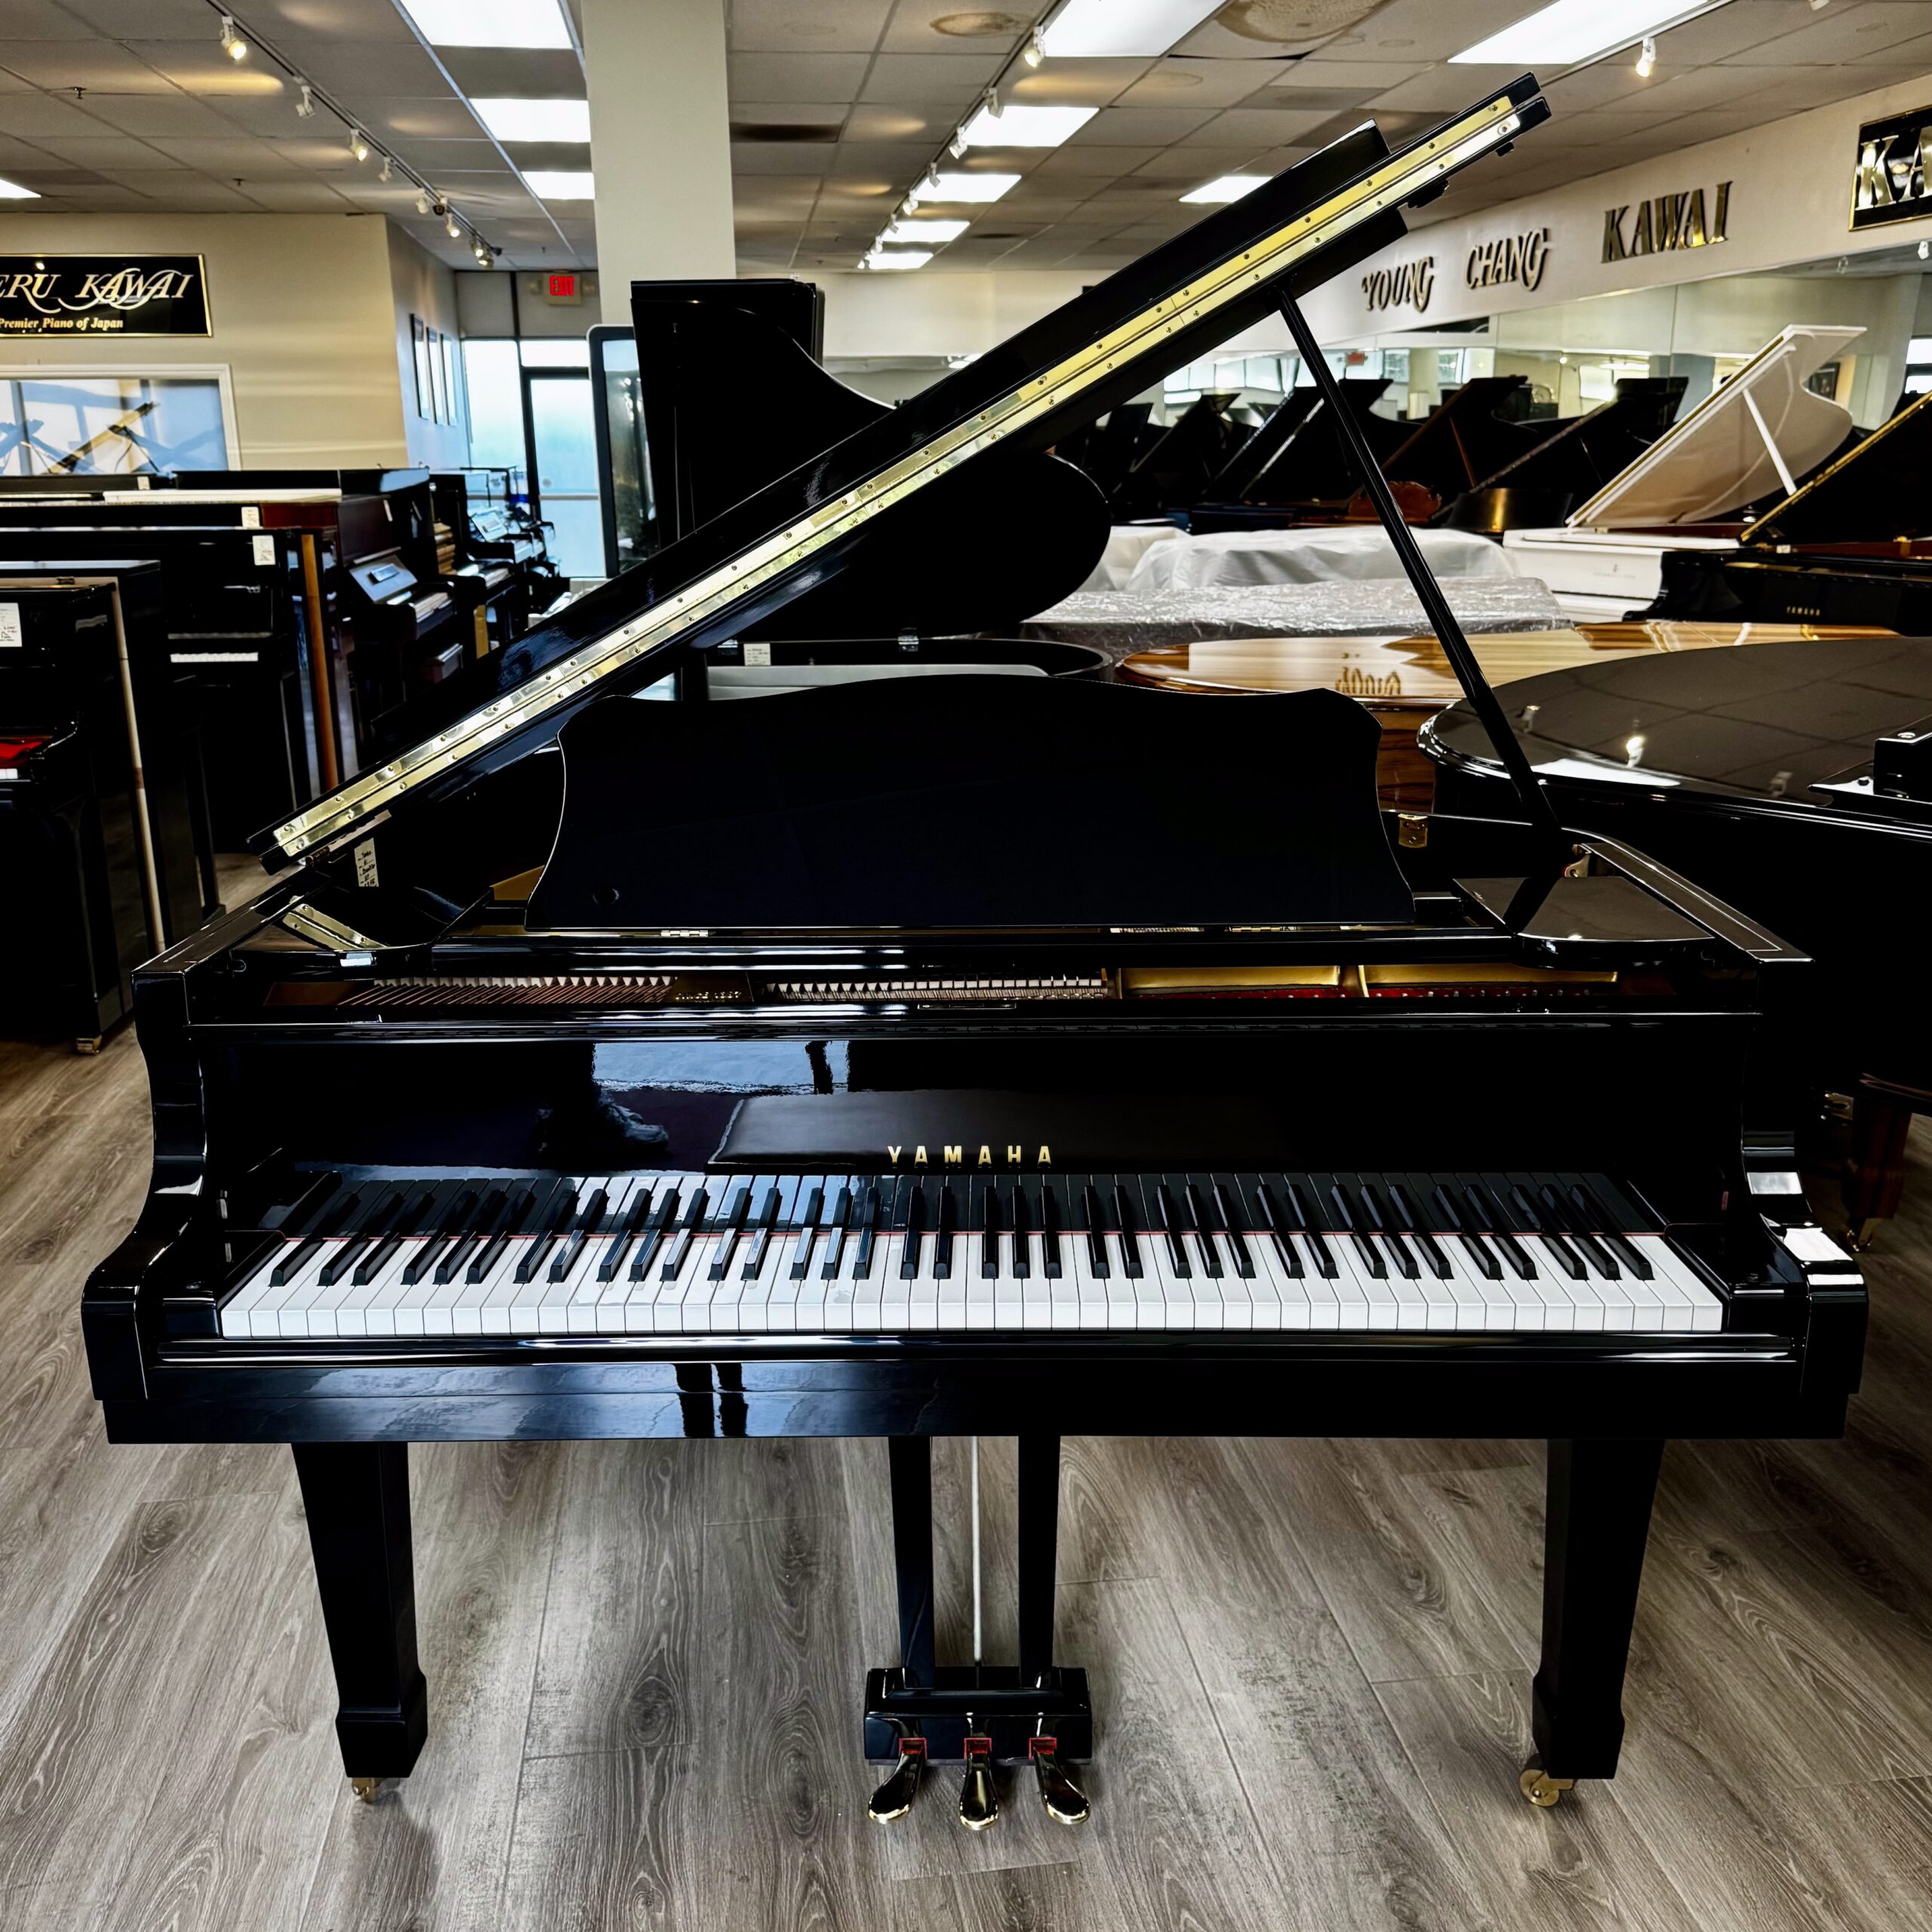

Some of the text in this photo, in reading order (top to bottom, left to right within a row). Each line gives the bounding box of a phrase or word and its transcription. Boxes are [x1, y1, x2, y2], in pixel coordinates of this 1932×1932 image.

[1601, 180, 1734, 263] KAWAI
[58, 267, 195, 311] KAWAI
[1361, 227, 1549, 313] YOUNG CHANG
[42, 317, 73, 328] Piano
[76, 317, 91, 331] of
[91, 317, 124, 331] Japan
[888, 1145, 1051, 1164] YAMAHA
